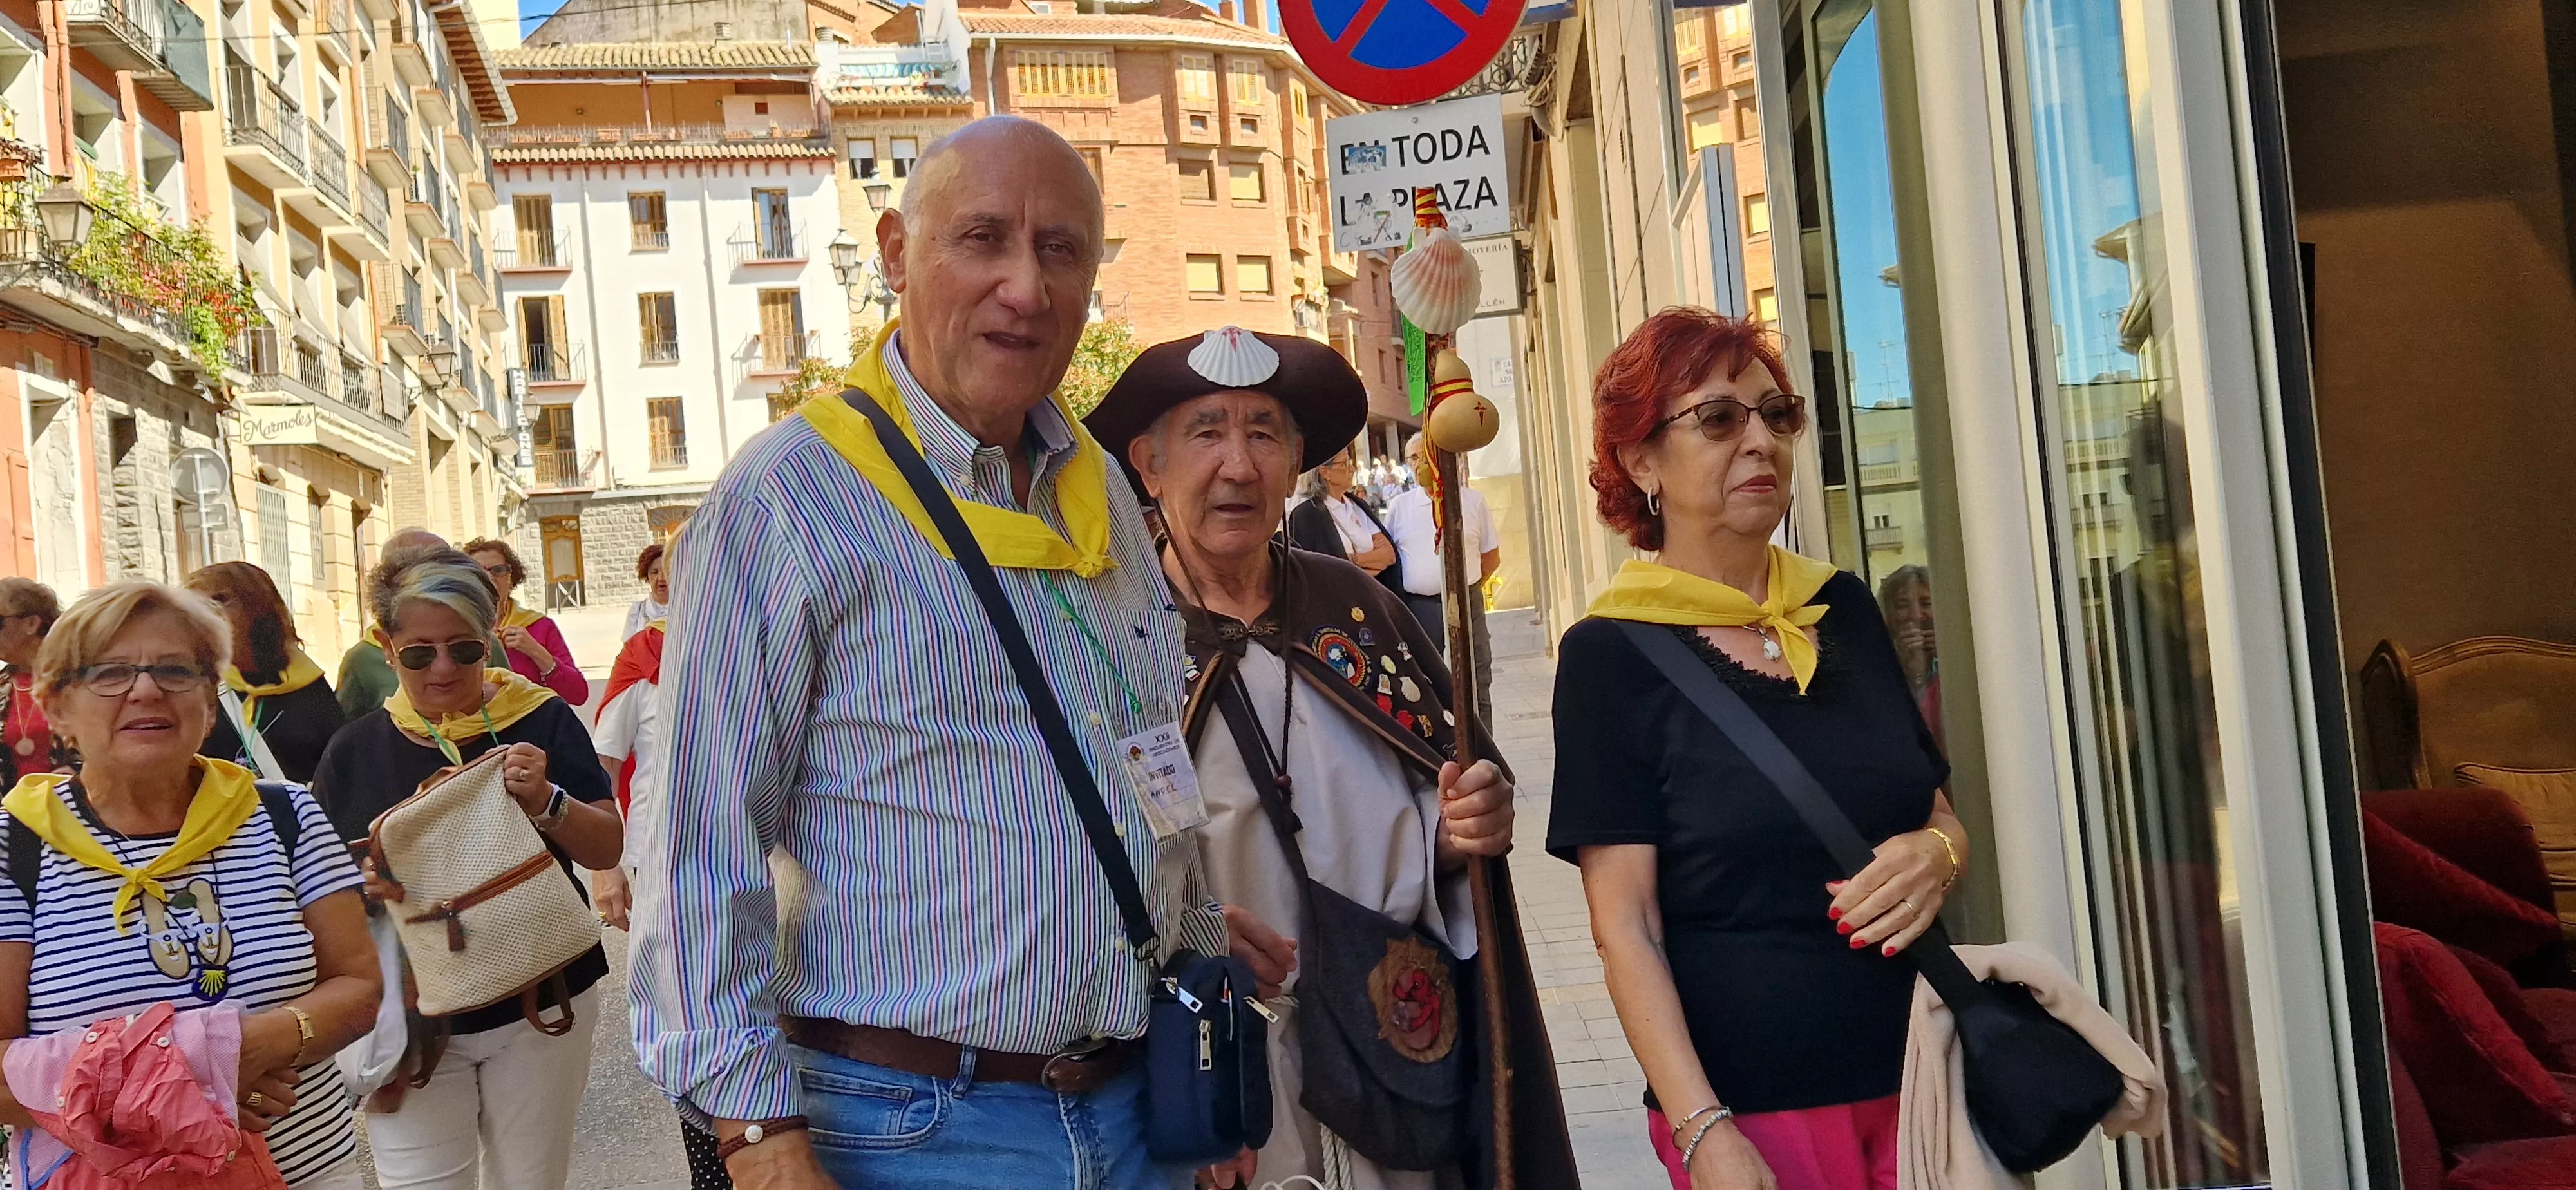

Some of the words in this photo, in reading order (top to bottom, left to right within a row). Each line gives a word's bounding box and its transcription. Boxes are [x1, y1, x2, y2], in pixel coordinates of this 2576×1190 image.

[1392, 125, 1490, 167] TODA
[1480, 298, 1505, 307] LLÉN
[243, 410, 314, 442] Marmoles
[1148, 764, 1176, 782] INVITADO
